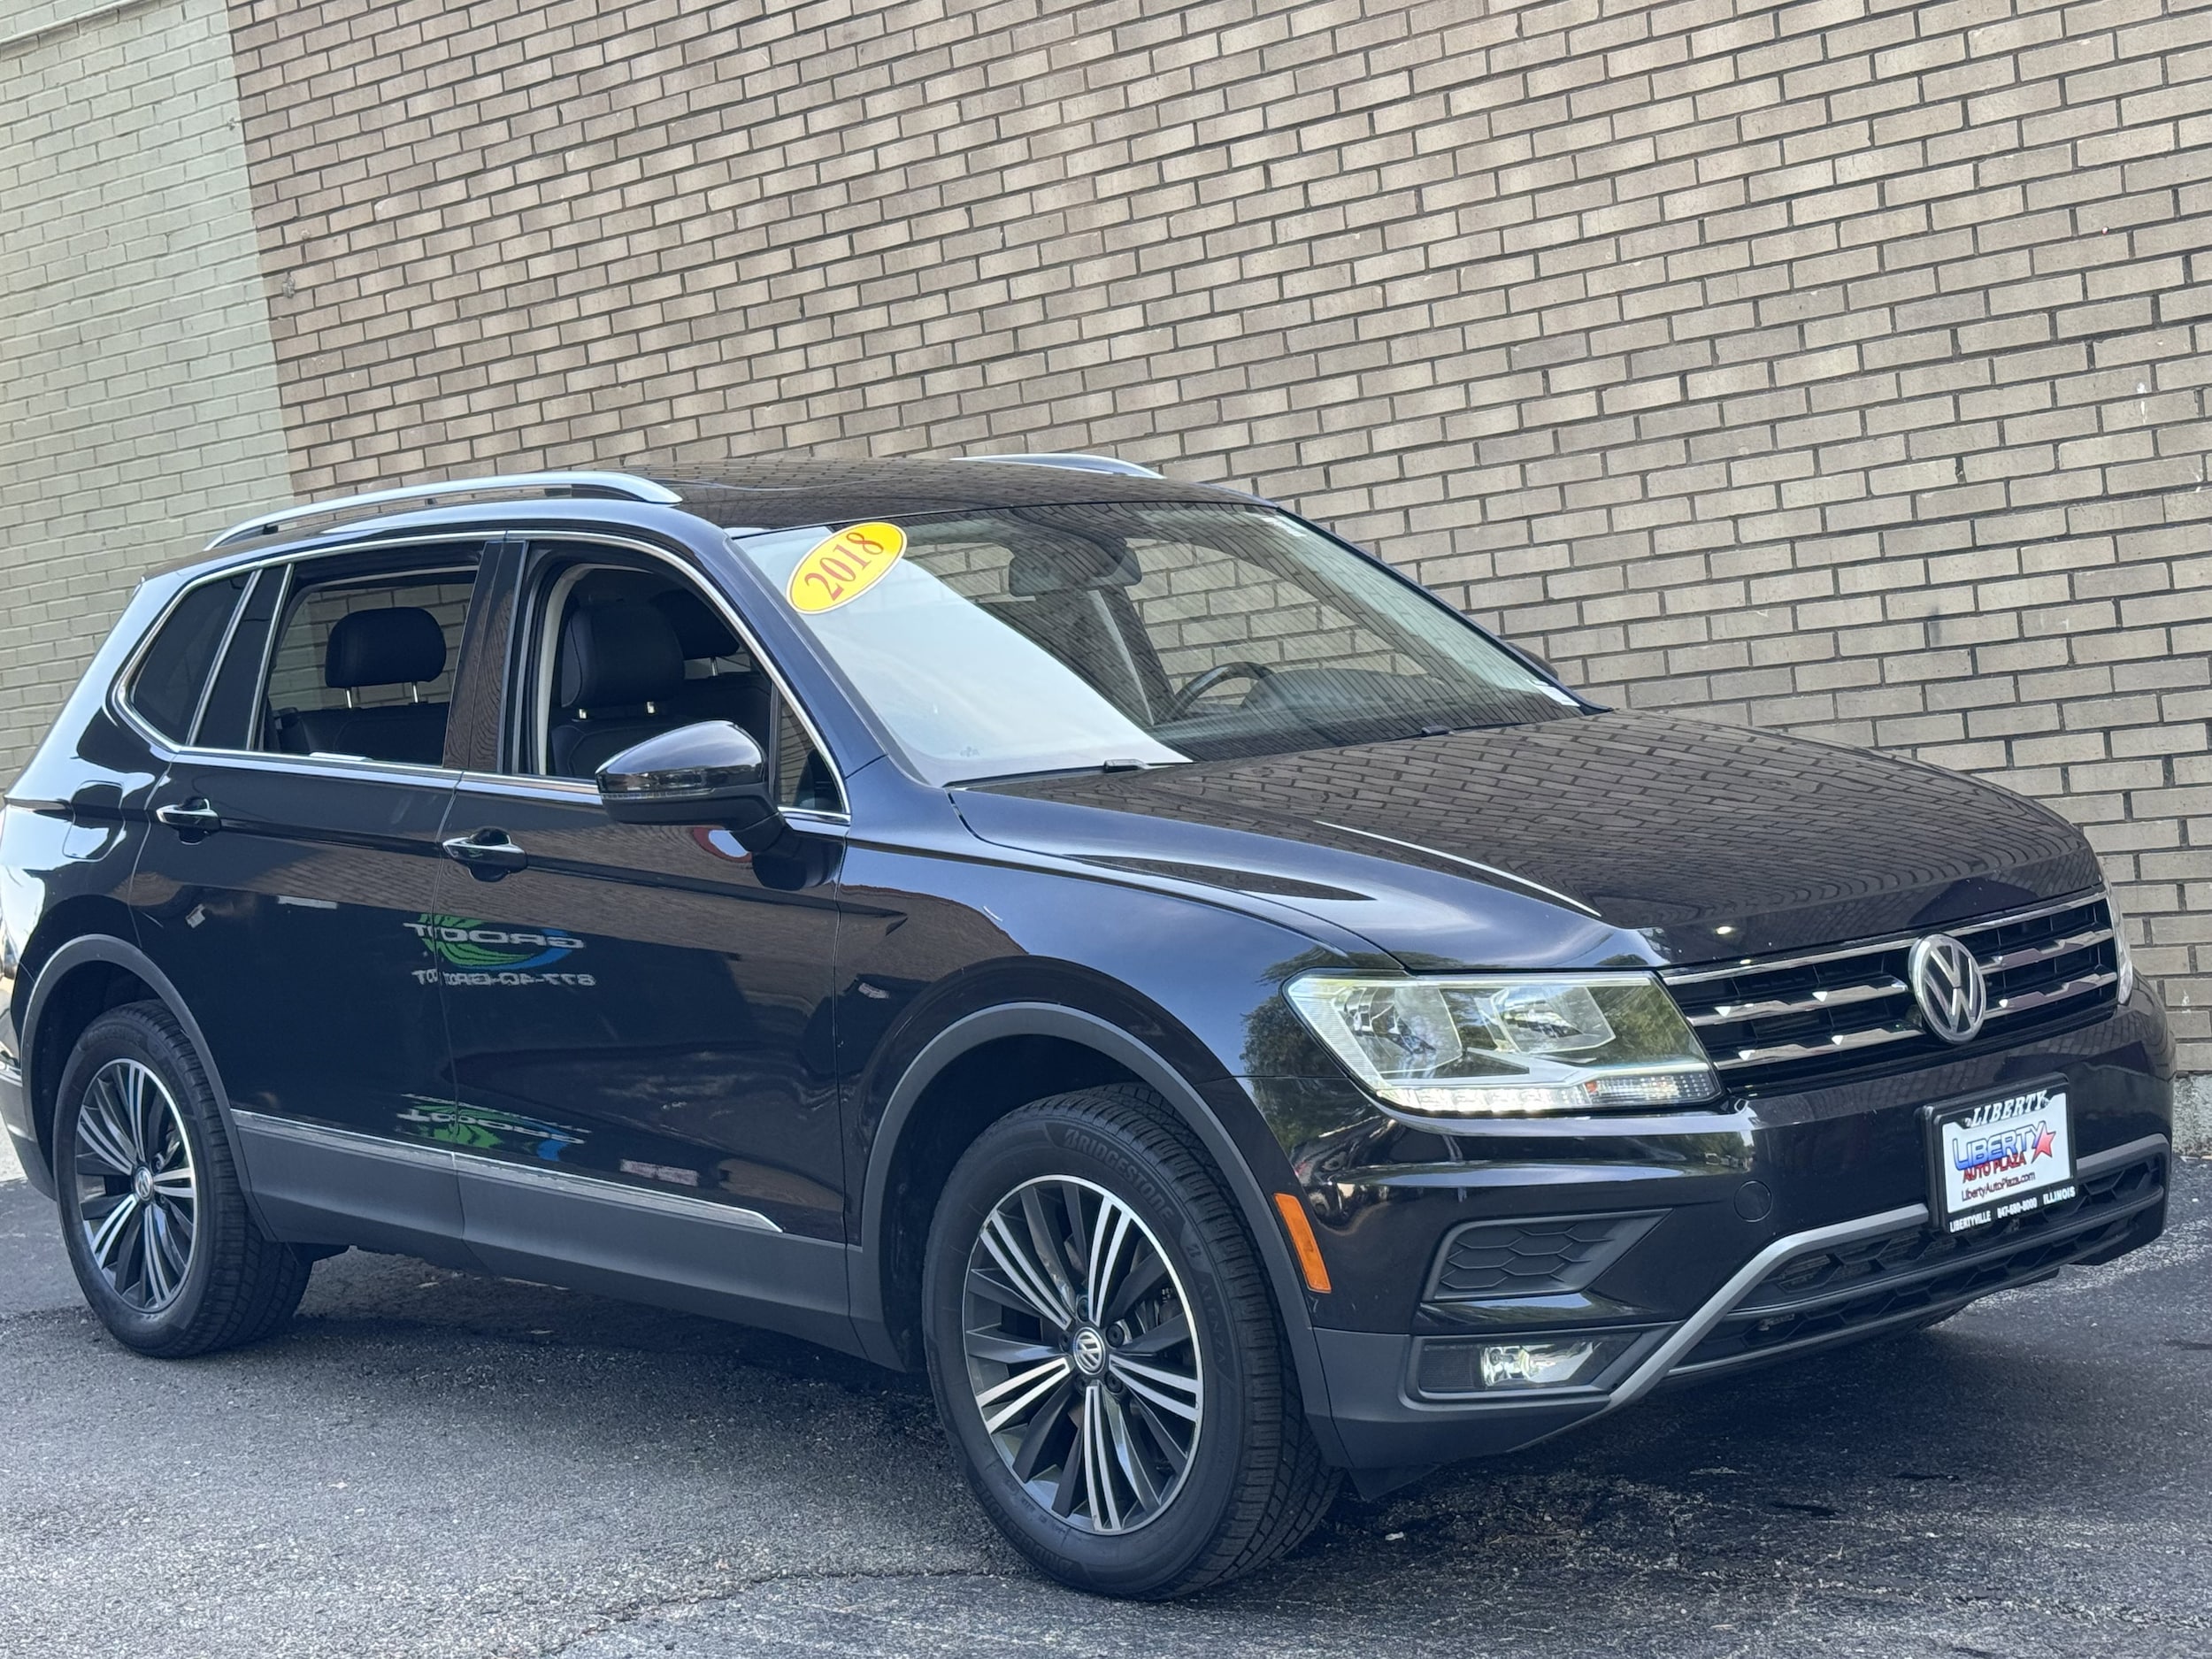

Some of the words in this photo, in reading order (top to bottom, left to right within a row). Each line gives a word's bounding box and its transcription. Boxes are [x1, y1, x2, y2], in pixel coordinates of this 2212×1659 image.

[803, 532, 885, 602] 2018
[1912, 933, 1986, 1044] VW
[1970, 1089, 2047, 1128] LIBERTY
[1952, 1120, 2047, 1171] LIBERTY
[1962, 1161, 1991, 1184] AUTO
[1993, 1150, 2027, 1175] PLAZA
[1064, 1128, 1176, 1221] BRIDGESTONE
[1962, 1171, 2036, 1202] LibertyAutoPlaza.com
[2043, 1187, 2076, 1205] ILLINOIS
